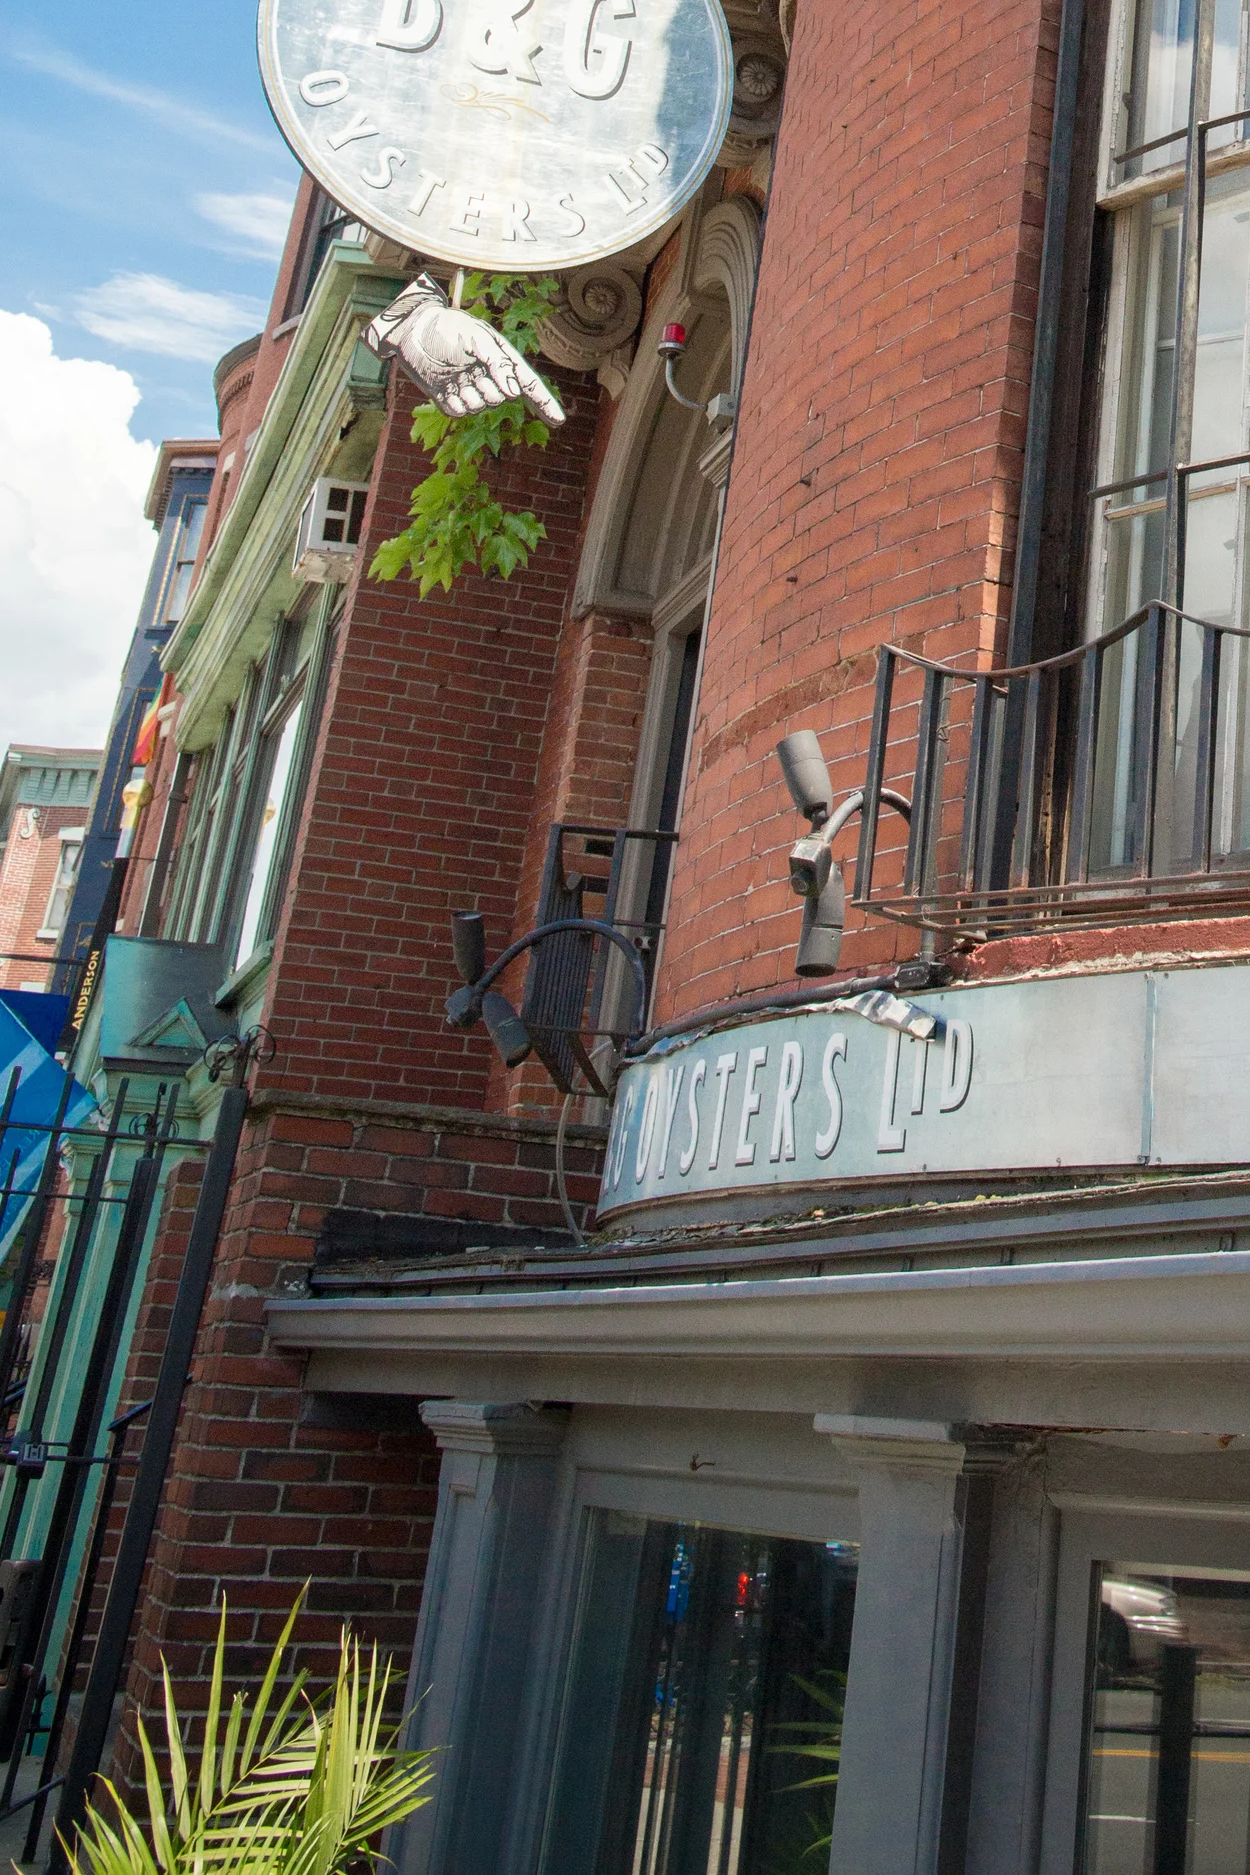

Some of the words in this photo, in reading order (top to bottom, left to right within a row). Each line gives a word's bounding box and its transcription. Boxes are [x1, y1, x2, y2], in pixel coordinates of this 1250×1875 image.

[299, 69, 586, 242] OYSTERS
[603, 141, 670, 217] LTD
[71, 950, 100, 1030] ANDERSON
[635, 1032, 849, 1185] OYSTERS
